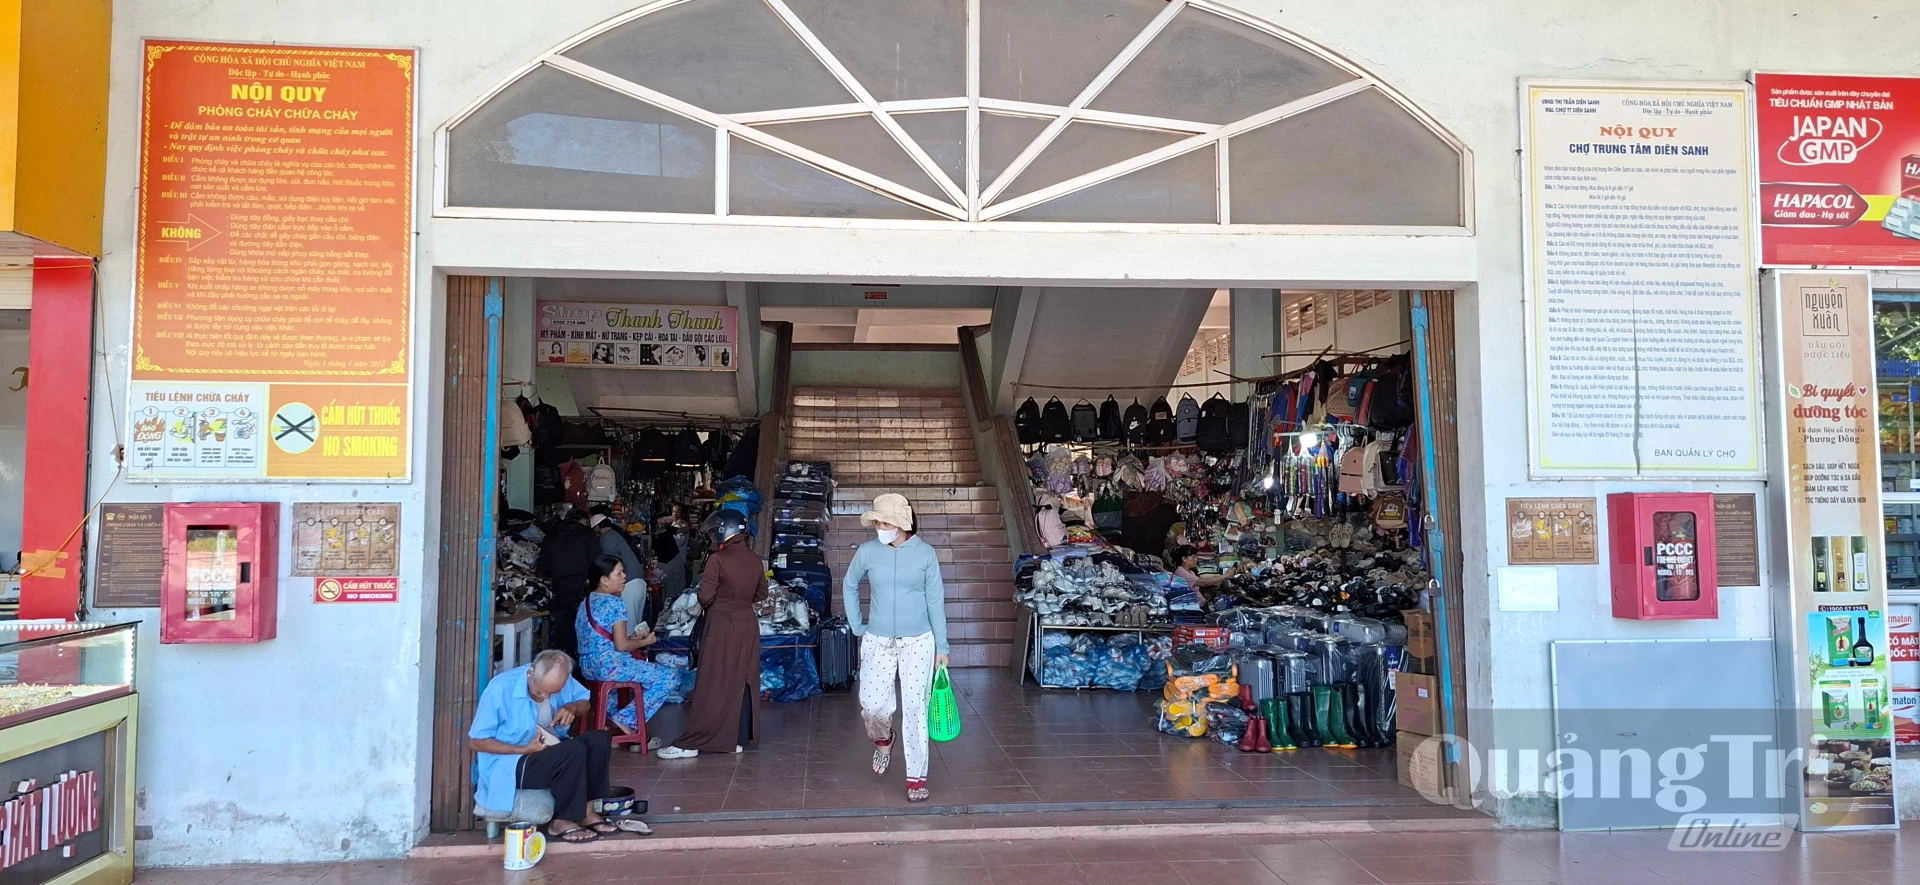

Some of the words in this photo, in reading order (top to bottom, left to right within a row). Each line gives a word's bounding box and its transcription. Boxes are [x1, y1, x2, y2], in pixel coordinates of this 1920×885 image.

[194, 54, 218, 66] CỘNG
[220, 55, 239, 65] HÒA
[241, 56, 254, 66] XÃ
[256, 56, 271, 67] HỘI
[273, 56, 291, 66] CHỦ
[293, 58, 320, 68] NGHĨA
[324, 59, 344, 69] VIỆT
[345, 60, 366, 68] NAM
[228, 68, 243, 78] Độc
[245, 69, 258, 78] lập
[263, 70, 274, 78] Tự
[291, 71, 312, 80] Hạnh
[313, 72, 330, 80] phúc
[231, 82, 272, 104] NỘI
[280, 86, 327, 103] QUY
[1622, 98, 1638, 107] CỘNG
[1661, 100, 1672, 108] HỘI
[1673, 99, 1686, 107] CHỦ
[1686, 100, 1704, 108] NGHĨA
[1706, 100, 1719, 108] VIỆT
[1769, 98, 1789, 108] TIÊU
[1790, 96, 1823, 108] CHUẨN
[1824, 100, 1844, 109] GMP
[1846, 99, 1872, 110] NHẬT
[1872, 100, 1894, 110] BẢN
[198, 104, 244, 118] PHÒNG
[246, 106, 282, 118] CHÁY
[284, 108, 320, 120] CHỮA
[323, 108, 359, 120] CHÁY
[170, 121, 184, 130] Để
[184, 122, 202, 130] đảm
[205, 122, 220, 130] bảo
[270, 125, 286, 134] sản,
[289, 126, 306, 134] tính
[308, 128, 332, 136] mạng
[334, 127, 350, 135] của
[352, 128, 368, 136] mọi
[369, 128, 394, 137] người
[1600, 124, 1633, 139] NỘI
[1638, 127, 1678, 139] QUY
[1788, 116, 1867, 142] JAPAN
[182, 134, 197, 142] trật
[199, 134, 208, 142] tự
[244, 136, 267, 144] trong
[280, 137, 301, 145] quan
[170, 142, 186, 152] Nay
[188, 144, 204, 152] quy
[204, 144, 224, 153] định
[226, 145, 242, 154] việc
[244, 145, 272, 155] phòng
[274, 146, 294, 156] cháy
[308, 147, 328, 155] chữa
[330, 148, 350, 157] cháy
[352, 148, 370, 156] như
[1569, 142, 1590, 155] CHỢ
[1592, 144, 1626, 154] TRUNG
[1630, 142, 1652, 154] TÂM
[1654, 144, 1678, 155] DIÊN
[1682, 146, 1708, 156] SANH
[1802, 142, 1854, 160] GMP
[1774, 194, 1855, 209] HAPACOL
[1774, 209, 1797, 220] Giảm
[1799, 210, 1816, 220] đau
[1822, 210, 1834, 220] Hạ
[162, 226, 202, 238] KHÔNG
[1805, 288, 1843, 312] nguyên
[542, 306, 602, 322] Shop
[606, 307, 662, 328] Thanh
[668, 309, 724, 330] Thanh
[1812, 310, 1840, 332] xuân
[1808, 340, 1826, 349] DẦU
[1830, 340, 1845, 350] GỘI
[1804, 352, 1829, 360] DƯỢC
[1831, 351, 1851, 360] LIỆU
[146, 391, 166, 402] TIÊU
[170, 392, 193, 403] LỆNH
[196, 392, 222, 402] CHỮA
[225, 392, 250, 402] CHÁY
[1802, 384, 1818, 398] Bí
[1820, 382, 1856, 402] quyết
[322, 398, 345, 426] CẤM
[347, 400, 366, 426] HÚT
[368, 398, 401, 426] THUỐC
[1793, 404, 1842, 422] dưỡng
[1844, 404, 1868, 418] tóc
[141, 423, 157, 432] BÁO
[137, 431, 162, 442] ĐỘNG
[1804, 435, 1836, 444] Phương
[1838, 434, 1860, 444] Đông
[323, 435, 340, 456] NO
[344, 435, 398, 456] SMOKING
[1654, 448, 1672, 457] BAN
[1675, 446, 1700, 457] QUẢN
[1702, 448, 1714, 458] LÝ
[1716, 449, 1736, 458] CHỢ
[1656, 542, 1693, 556] PCCC
[188, 568, 234, 582] PCCC
[343, 580, 358, 590] CẤM
[360, 581, 373, 590] HÚT
[374, 580, 396, 590] THUỐC
